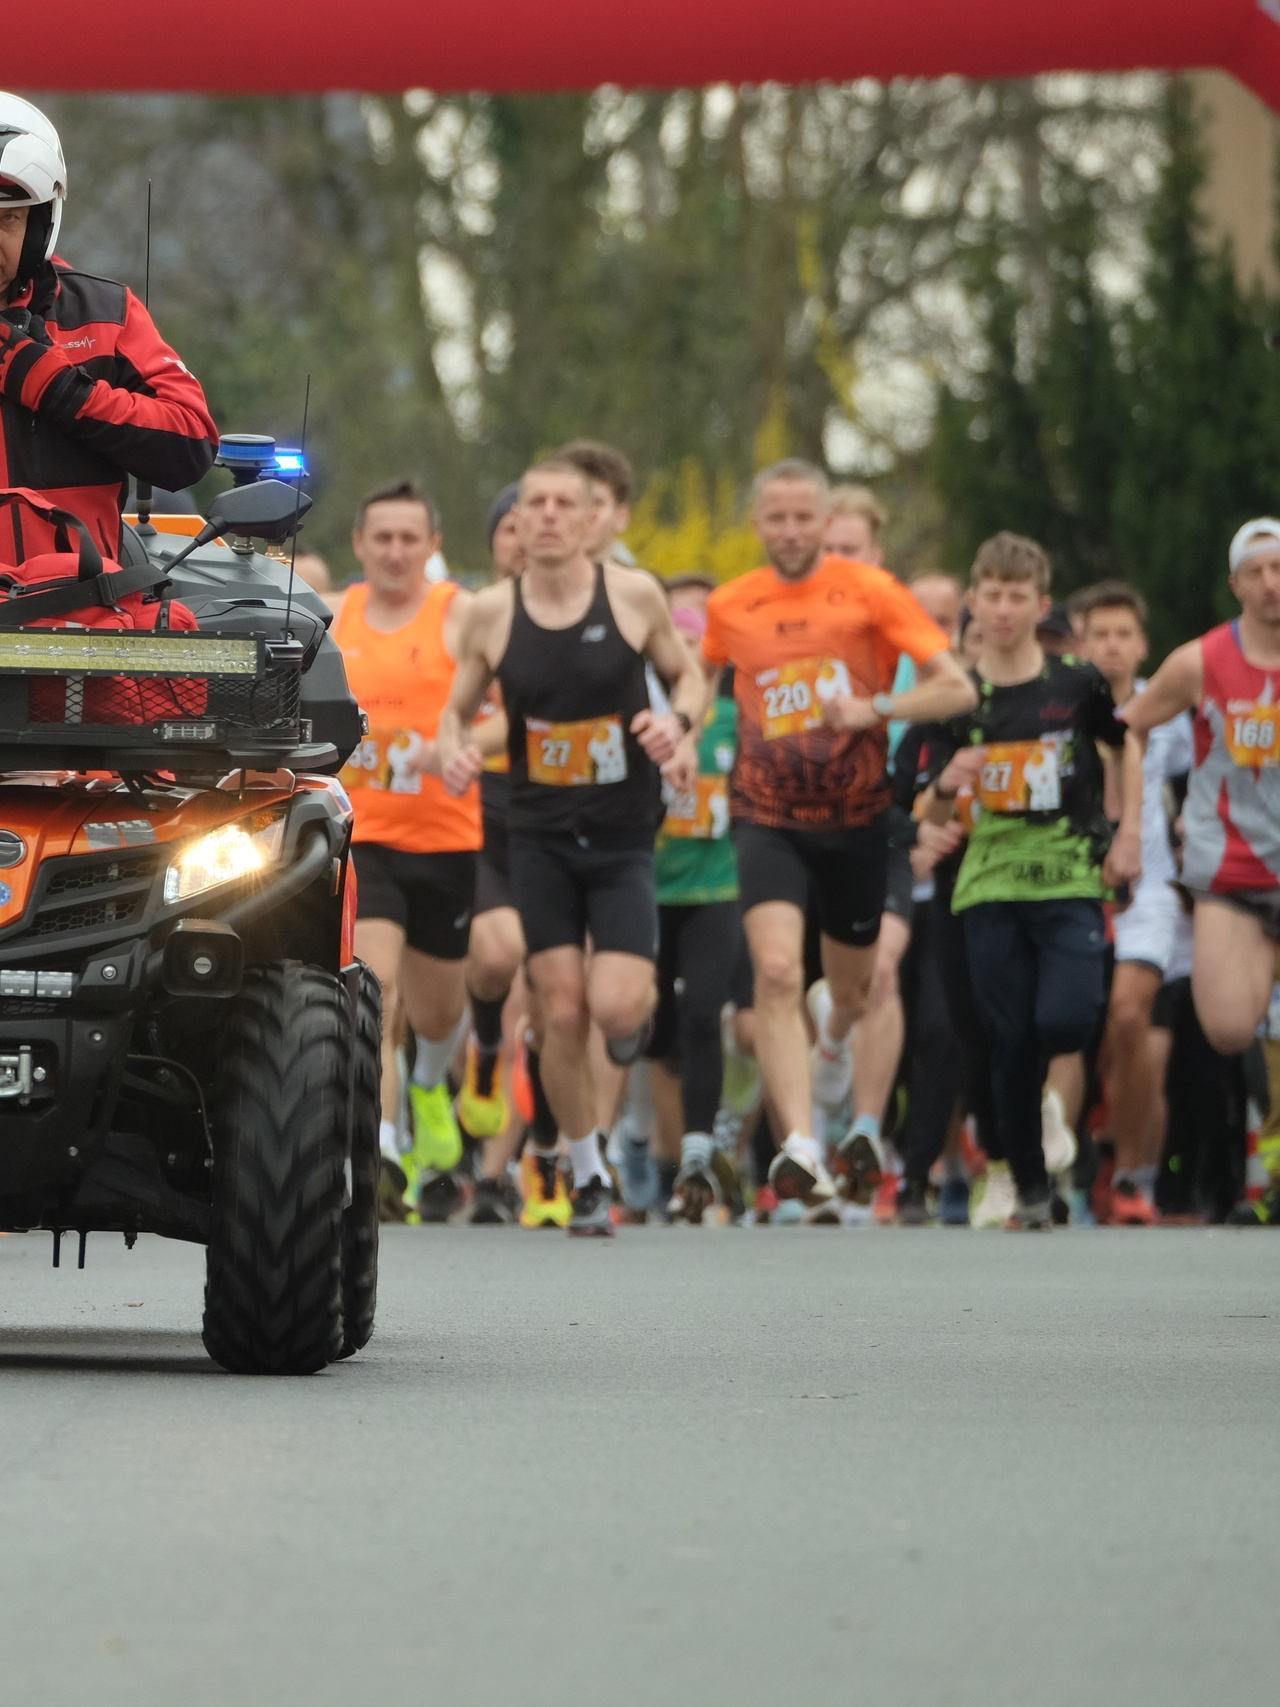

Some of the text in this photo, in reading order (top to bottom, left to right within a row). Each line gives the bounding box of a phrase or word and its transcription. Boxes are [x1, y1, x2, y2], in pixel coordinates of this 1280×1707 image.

[763, 680, 812, 719] 220
[1233, 716, 1276, 750] 168
[540, 739, 572, 768] 27
